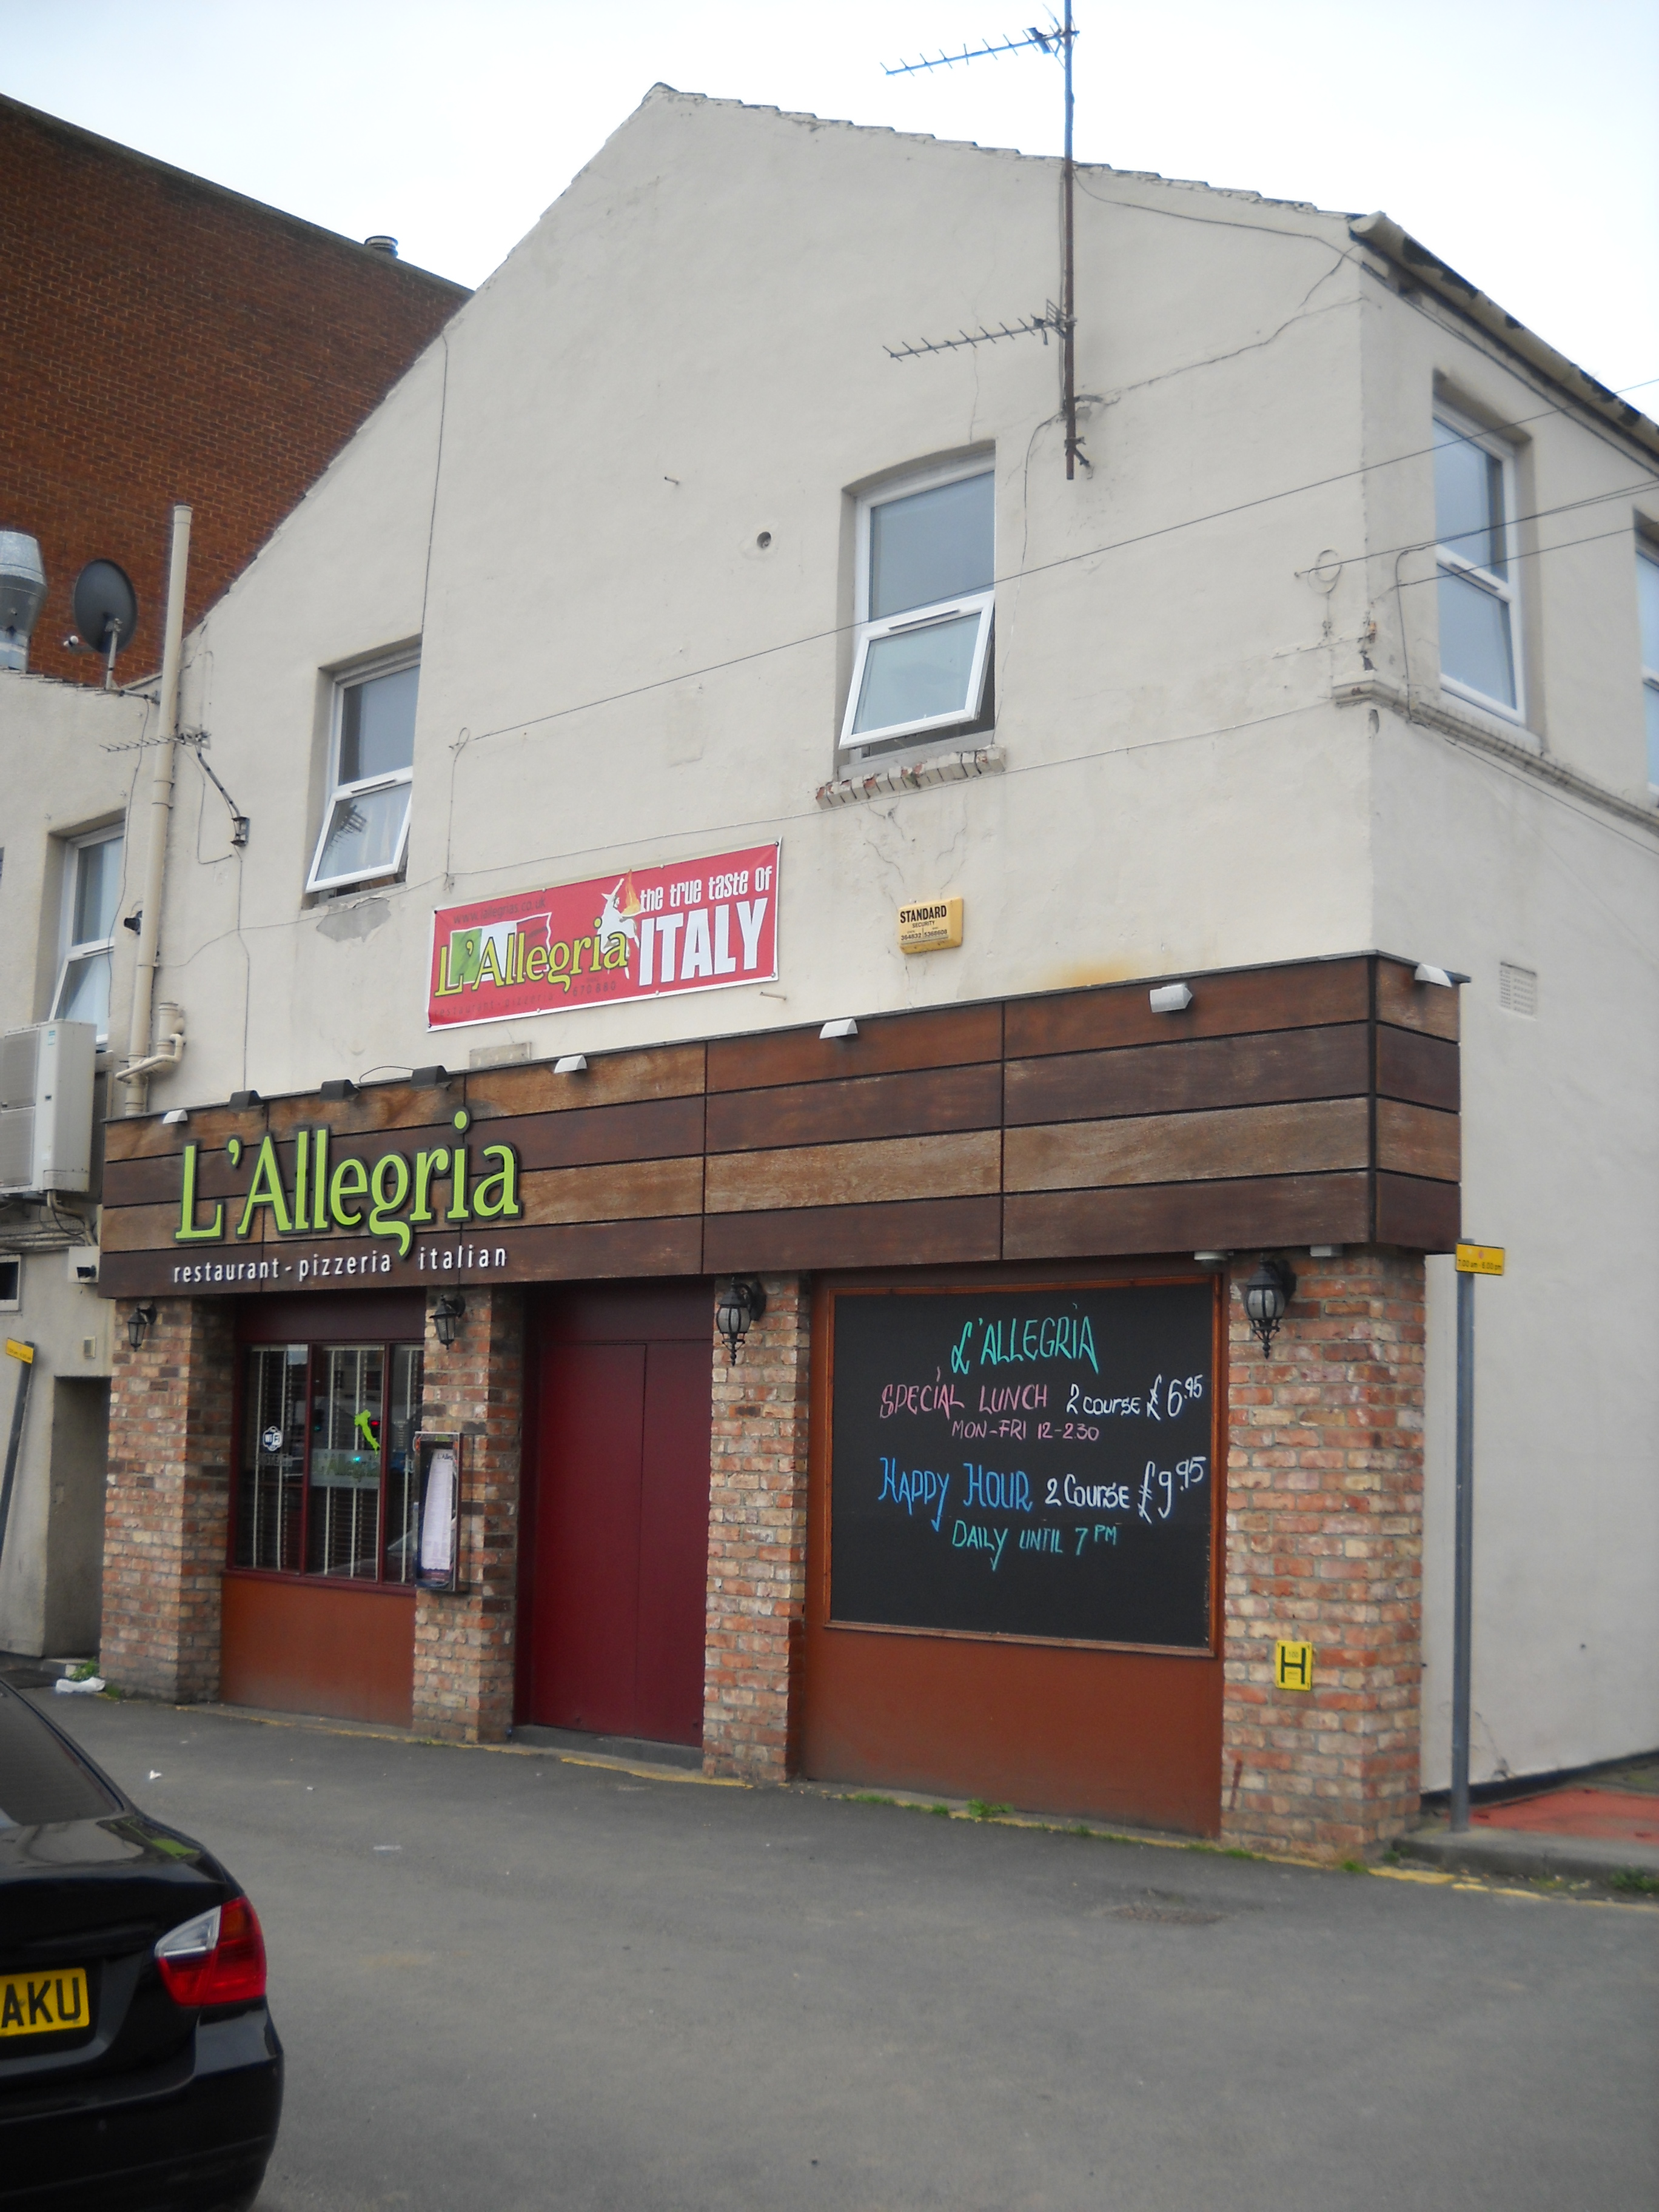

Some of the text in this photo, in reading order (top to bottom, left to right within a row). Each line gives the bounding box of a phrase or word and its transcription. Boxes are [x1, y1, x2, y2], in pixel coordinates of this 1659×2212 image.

[640, 886, 663, 912] the
[670, 879, 702, 907] true
[708, 870, 748, 900] taste
[900, 905, 947, 923] STANDARD
[434, 918, 629, 996] L'Allegria
[639, 897, 768, 987] ITALY
[175, 1110, 520, 1256] L'Allegria
[174, 1258, 279, 1283] restaurant
[298, 1250, 391, 1282] pizzeria
[419, 1244, 507, 1270] italian
[951, 1302, 1099, 1375] L'ALLEGRIA
[880, 1366, 965, 1420] SPECIAL
[979, 1384, 1048, 1415] LUNCH
[1066, 1383, 1079, 1415] 2
[963, 1462, 1033, 1512] HOUR
[1045, 1478, 1062, 1507] 2
[952, 1520, 1117, 1572] DAILY UNTIL 7 PM
[1281, 1646, 1306, 1685] H
[1, 1977, 81, 2028] AKU
